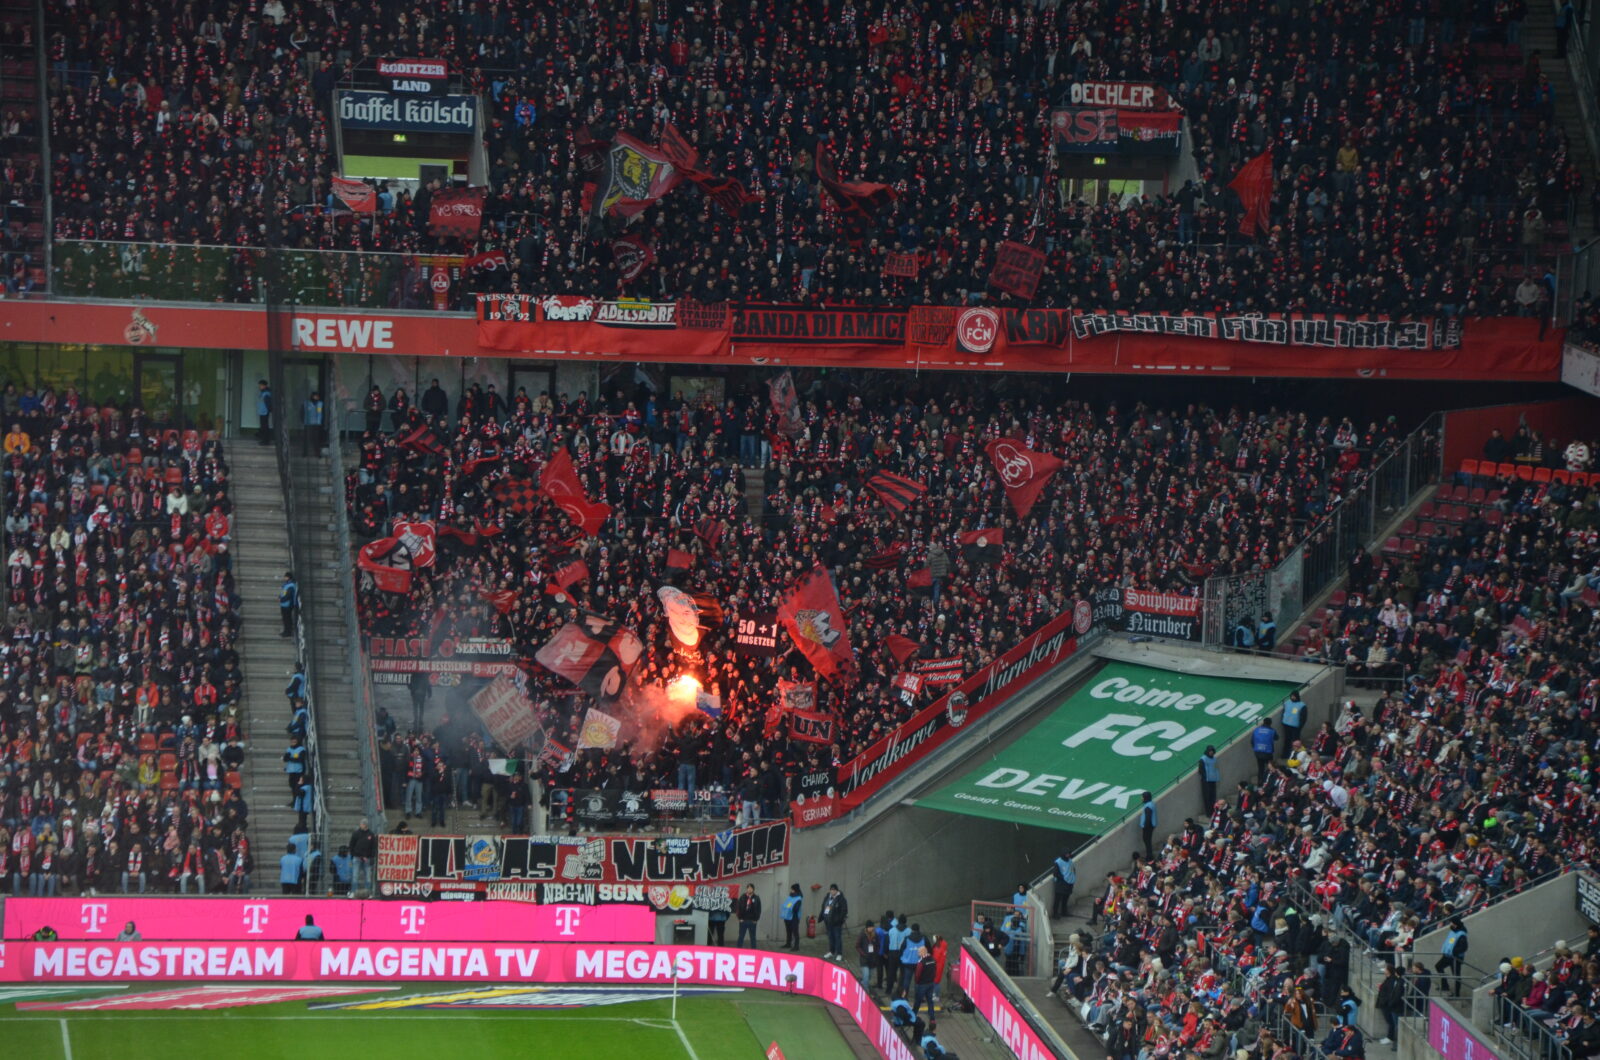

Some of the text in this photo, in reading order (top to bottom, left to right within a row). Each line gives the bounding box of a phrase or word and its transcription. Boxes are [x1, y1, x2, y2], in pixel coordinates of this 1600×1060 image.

[393, 80, 431, 92] LAND
[1070, 83, 1154, 107] OECHLER
[340, 97, 473, 128] Gaffel Kölsch
[489, 312, 531, 320] 19 92
[597, 304, 675, 321] ADELSDORF
[293, 319, 394, 349] REWE
[731, 311, 810, 337] BANDA
[813, 313, 837, 336] DI
[840, 314, 907, 339] AMICI
[966, 317, 992, 341] 1. FCN
[1220, 312, 1287, 344] FÜR
[738, 619, 756, 635] 50
[771, 623, 778, 638] 1
[456, 643, 511, 656] SEENLAND
[737, 634, 776, 648] UMSETZEN
[374, 673, 412, 684] NEUMARKT
[1090, 677, 1207, 711] Come
[793, 715, 833, 740] UN
[843, 632, 1065, 799] Nordkurve Nürnberg
[1062, 713, 1216, 762] FC!
[802, 772, 829, 788] CHAMPS
[975, 767, 1148, 810] DEVK
[955, 792, 1109, 824] Gesagt. Getan. Geholfen.
[378, 836, 417, 851] SEKTION
[378, 853, 416, 866] STADION
[378, 867, 415, 881] VERBOT
[598, 884, 644, 902] SGN
[33, 948, 284, 977] MEGASTREAM
[319, 948, 540, 978] MAGENTA TV
[575, 950, 806, 989] MEGASTREAM
